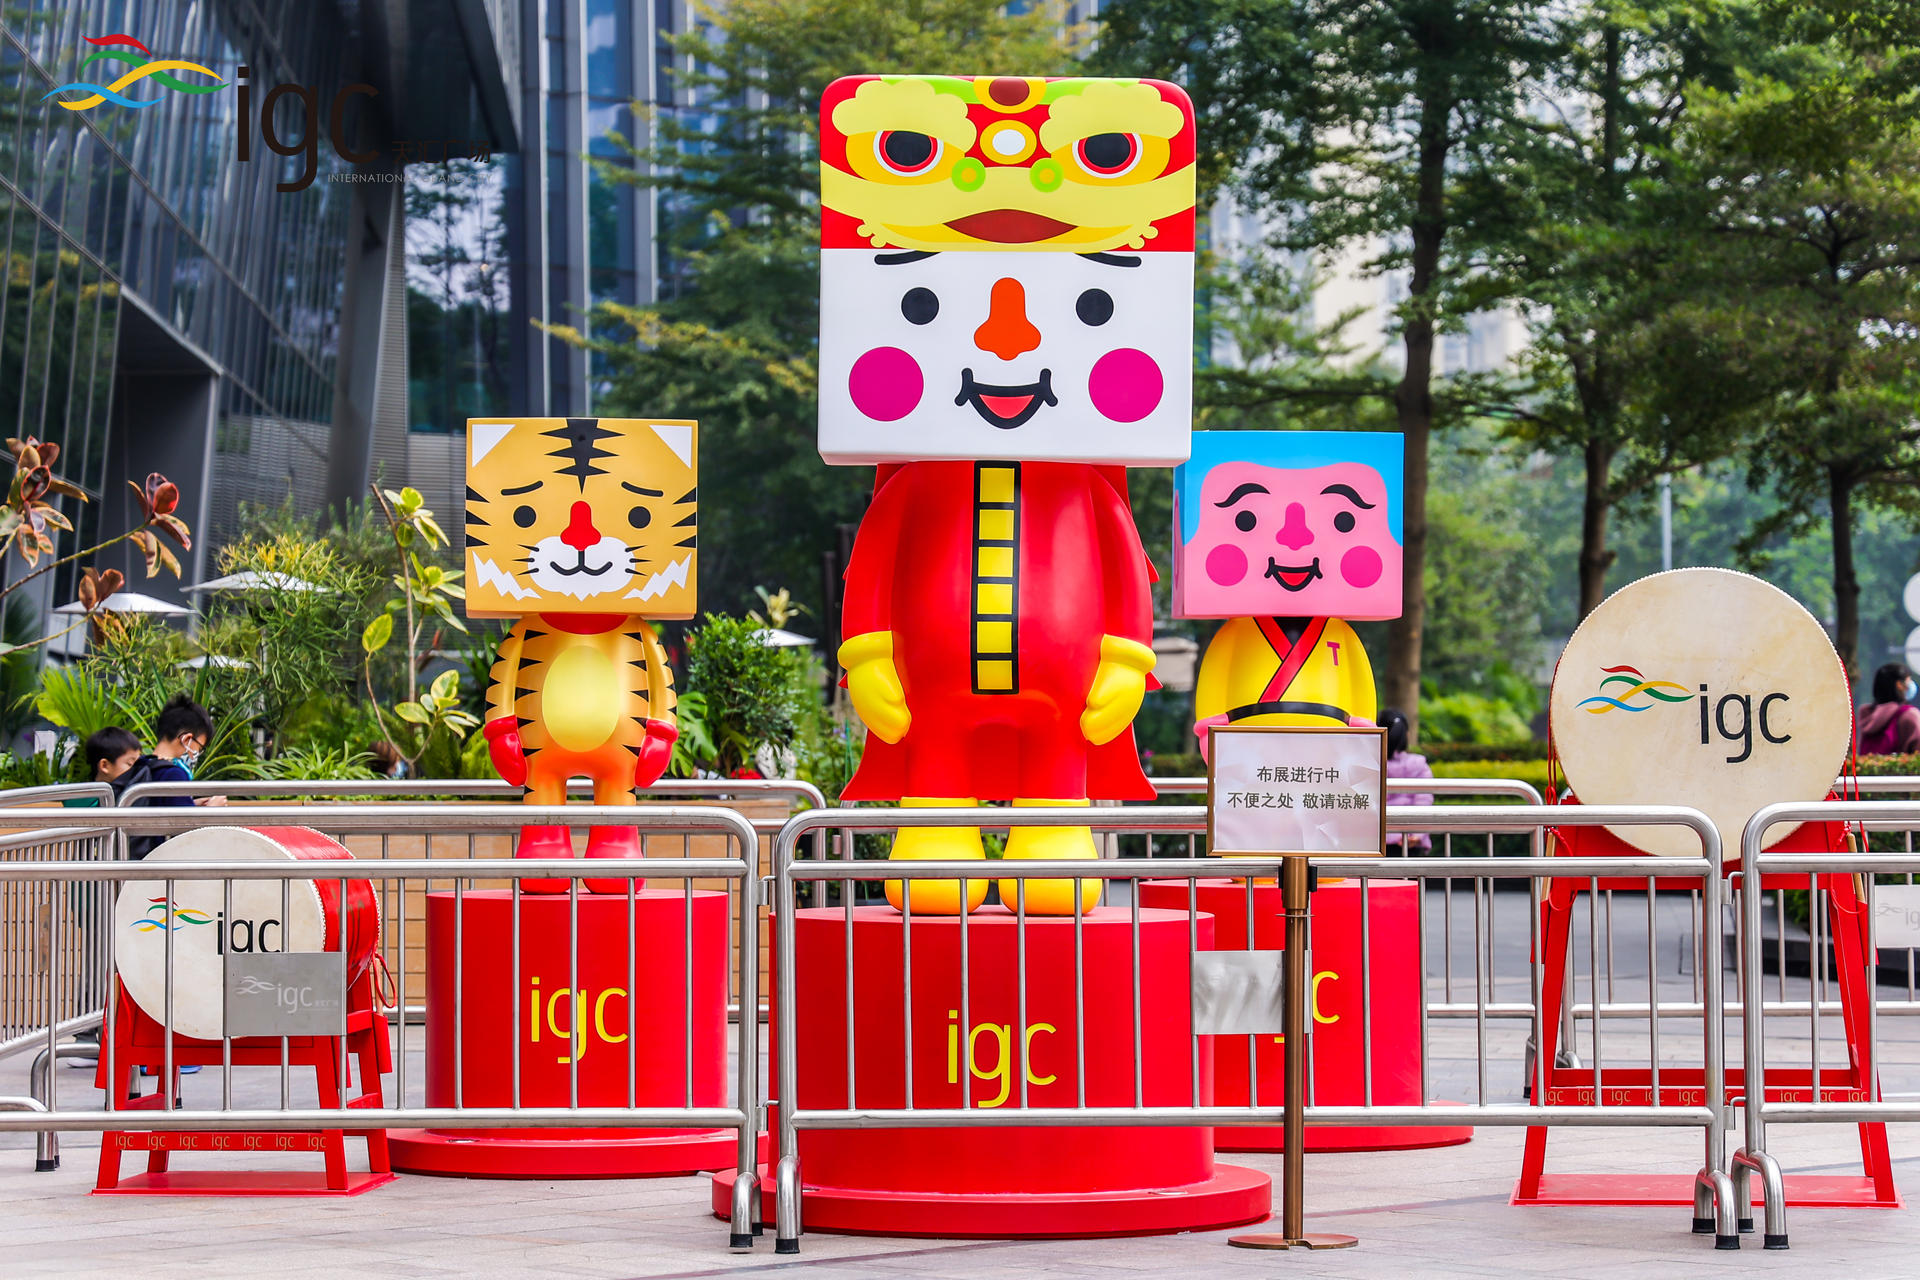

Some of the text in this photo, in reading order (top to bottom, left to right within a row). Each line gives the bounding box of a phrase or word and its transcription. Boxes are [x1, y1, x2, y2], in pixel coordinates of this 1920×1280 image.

[1327, 641, 1340, 666] T
[1699, 683, 1792, 763] igc
[1257, 766, 1340, 784] 布展进行中
[1227, 792, 1370, 810] 不便之处 敬请谅解
[276, 983, 313, 1014] igc
[531, 976, 629, 1064] igc
[947, 1009, 1057, 1108] igc
[1611, 1088, 1631, 1106] igc
[1679, 1088, 1699, 1106] igc
[115, 1133, 327, 1151] igc igc igc igc igc igc igc
